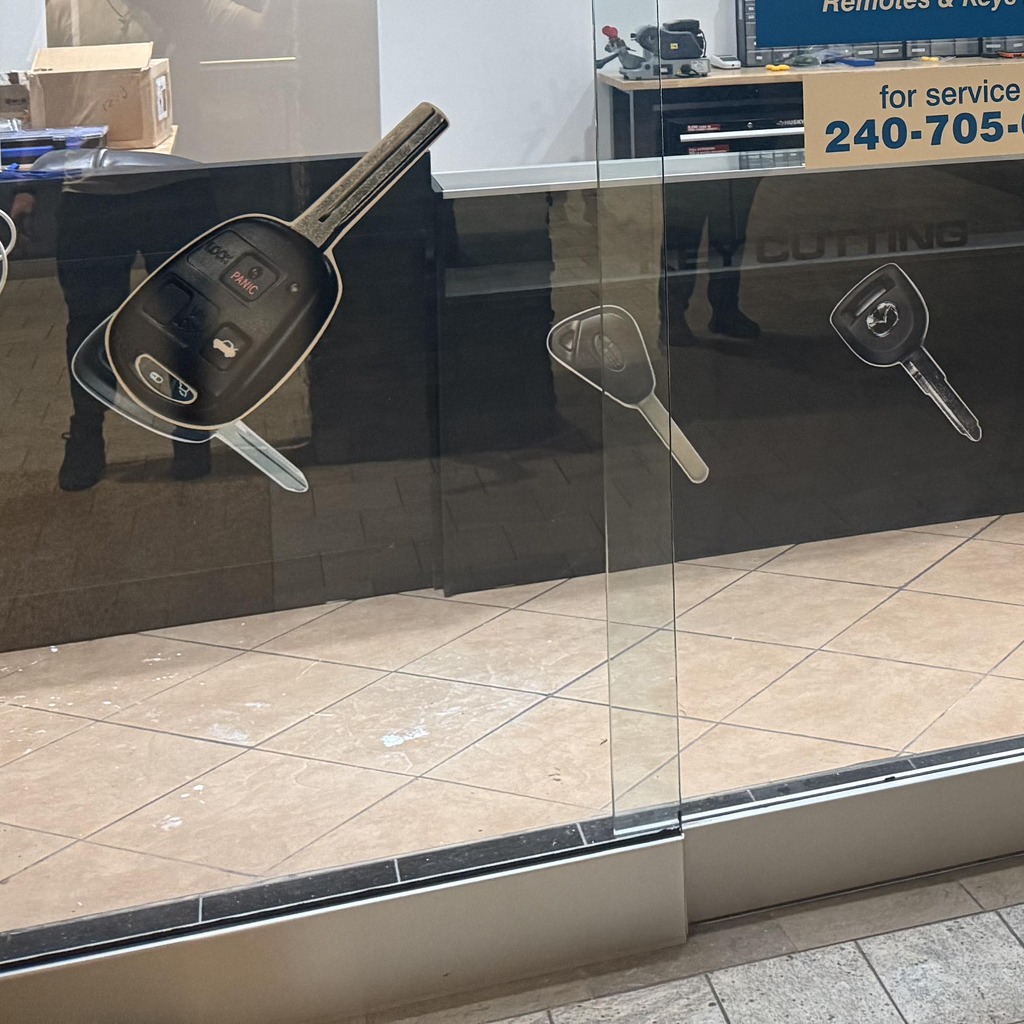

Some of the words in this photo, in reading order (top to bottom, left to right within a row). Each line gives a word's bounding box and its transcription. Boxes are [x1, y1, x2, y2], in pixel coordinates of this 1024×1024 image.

[879, 84, 917, 109] for
[925, 79, 1021, 106] service
[756, 220, 968, 264] CUTTING
[230, 271, 259, 295] PANIC
